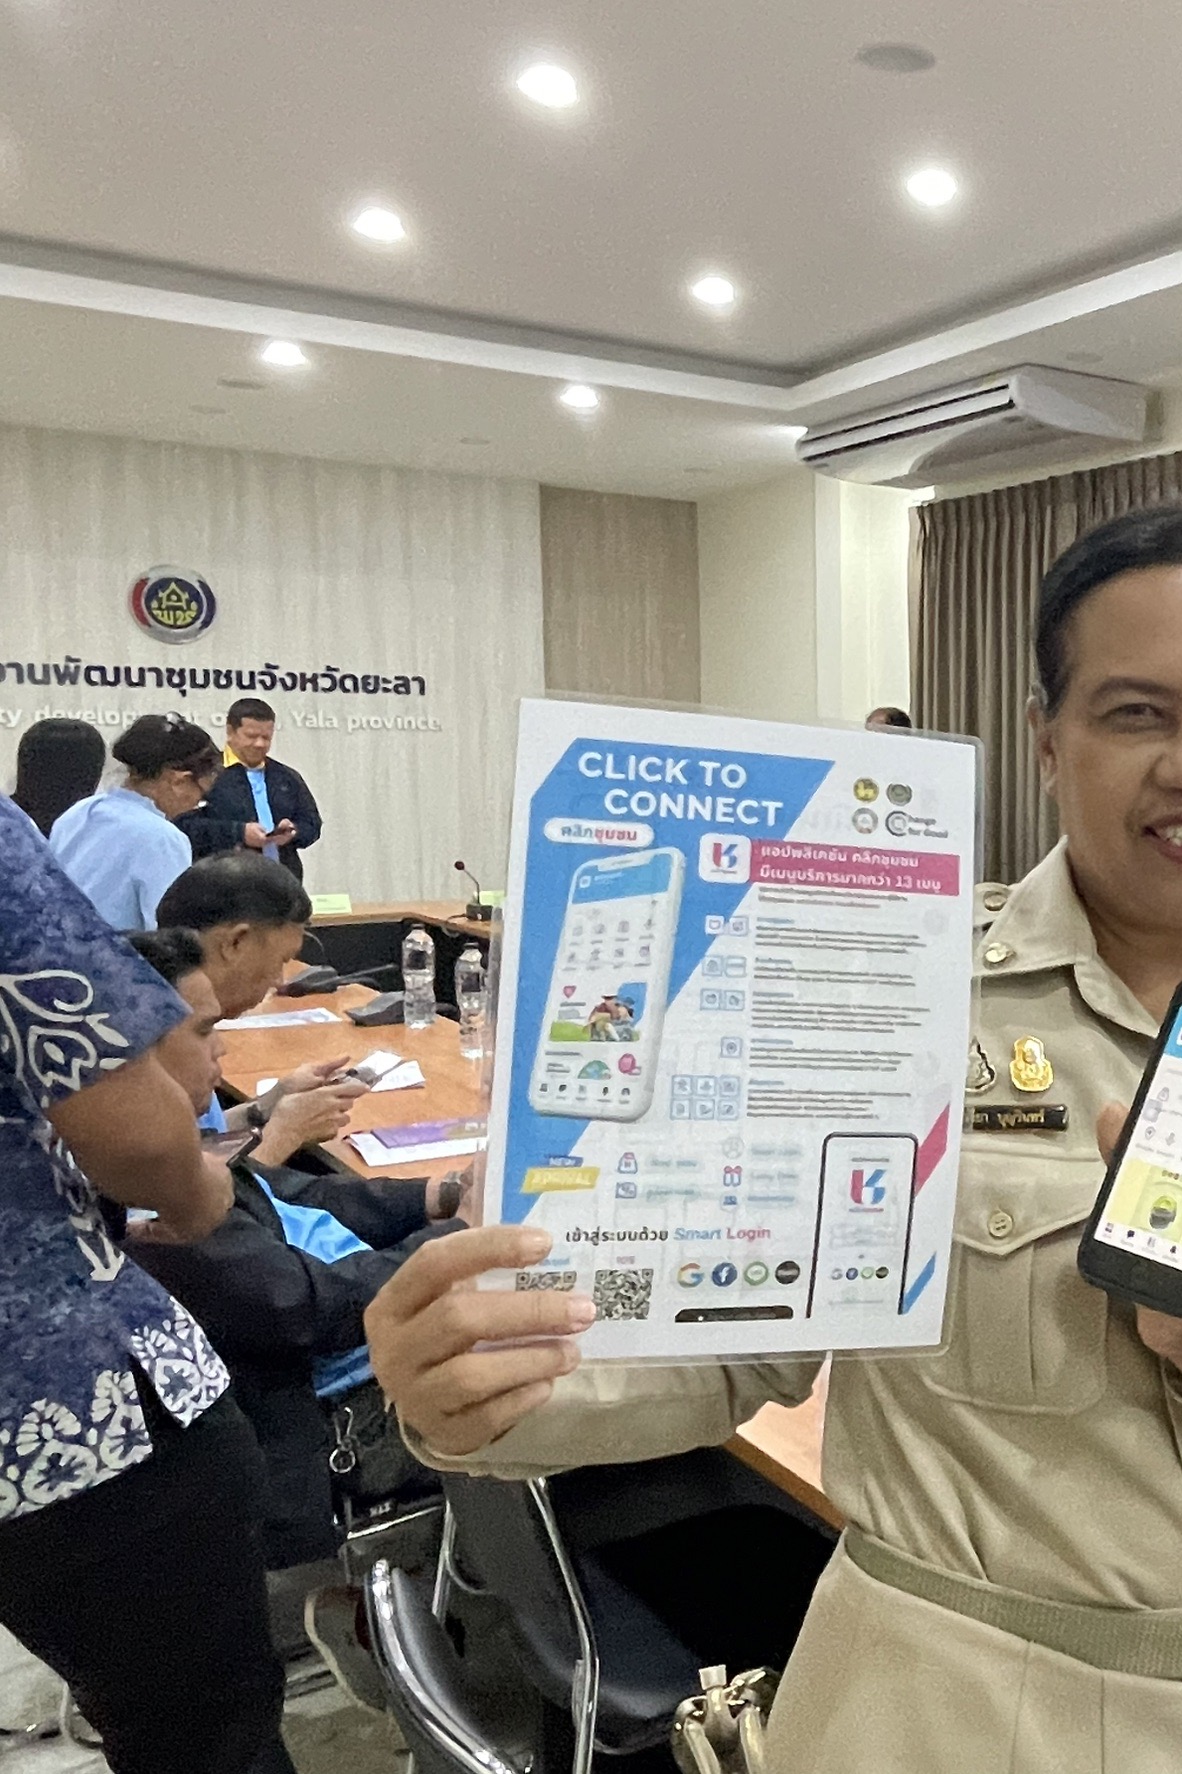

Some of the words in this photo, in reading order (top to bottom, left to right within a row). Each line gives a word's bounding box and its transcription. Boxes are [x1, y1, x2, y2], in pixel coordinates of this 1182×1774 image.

[291, 709, 339, 729] Yala
[578, 751, 691, 785] CLICK
[699, 760, 747, 789] TO
[604, 788, 783, 827] CONNECT
[566, 1227, 668, 1246] เข้าสู่ระบบด้วย
[673, 1228, 721, 1241] Smart
[726, 1227, 771, 1242] Login
